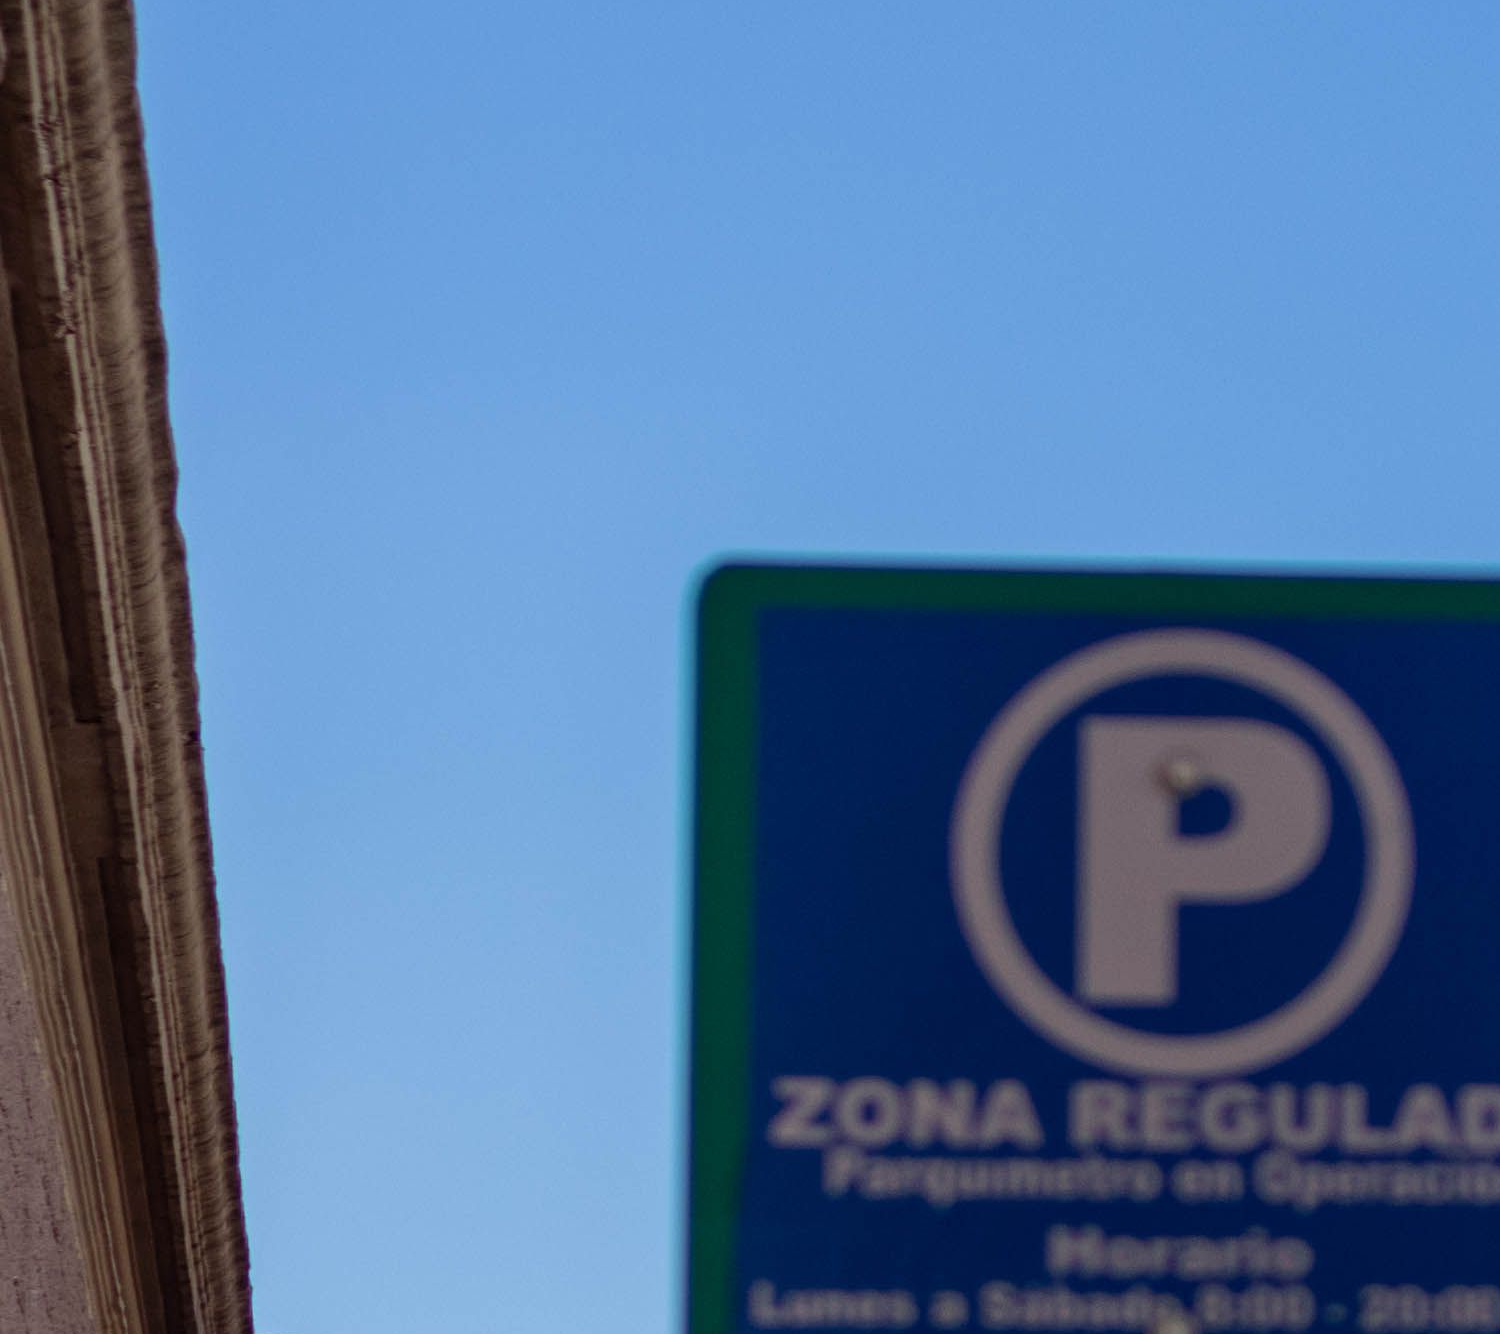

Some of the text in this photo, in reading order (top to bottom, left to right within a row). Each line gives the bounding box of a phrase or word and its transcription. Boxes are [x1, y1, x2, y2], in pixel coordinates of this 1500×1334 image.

[1076, 712, 1336, 1008] P
[769, 1076, 1041, 1150] ZONA
[1173, 1161, 1244, 1200] en
[1046, 1225, 1313, 1279] Horario
[749, 1281, 916, 1327] Lunes
